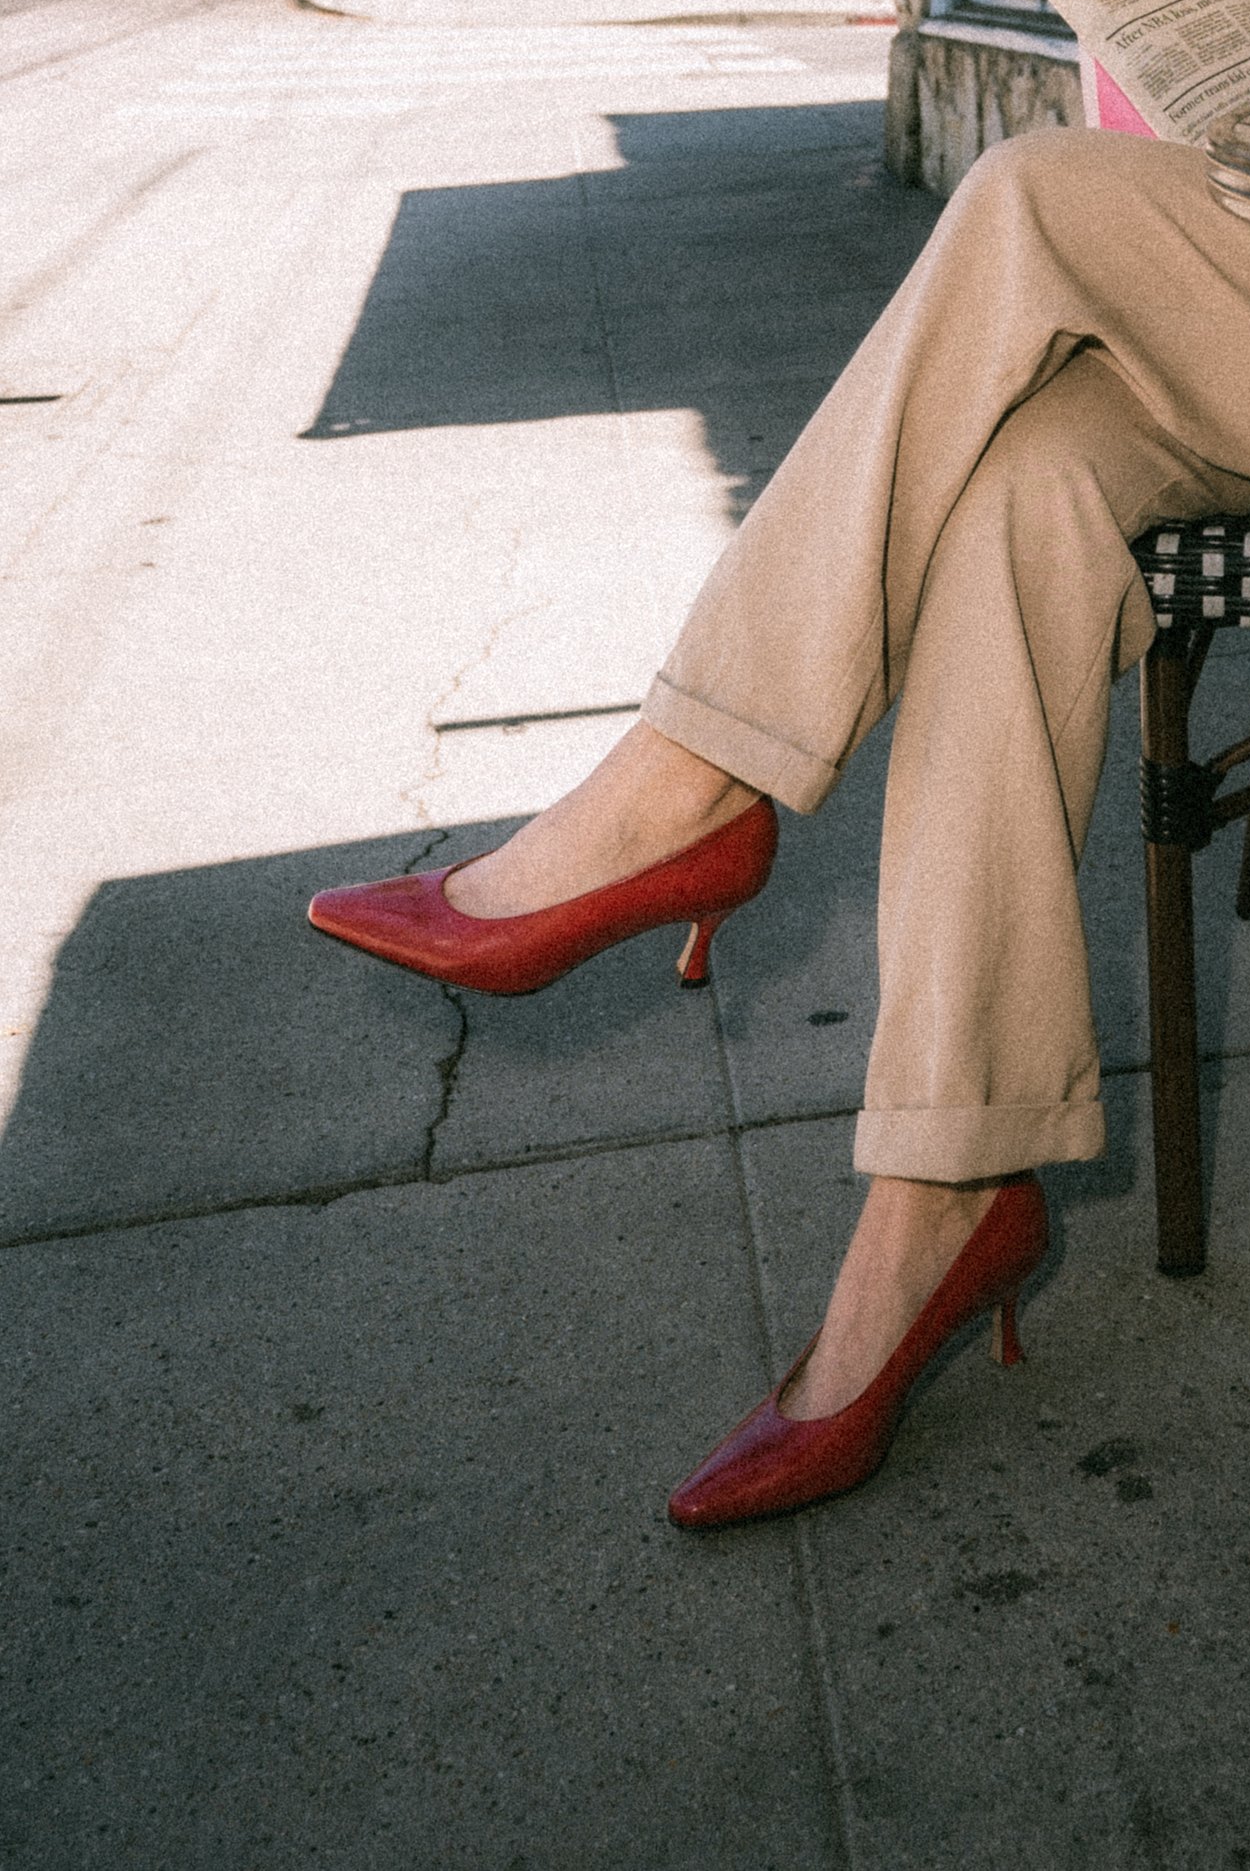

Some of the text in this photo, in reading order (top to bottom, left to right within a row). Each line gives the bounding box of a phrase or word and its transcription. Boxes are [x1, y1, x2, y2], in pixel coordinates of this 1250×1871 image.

[1116, 28, 1144, 53] After
[1141, 13, 1174, 30] NBA
[1168, 92, 1206, 124] Former
[1204, 78, 1231, 98] trans
[1227, 67, 1248, 86] kid
